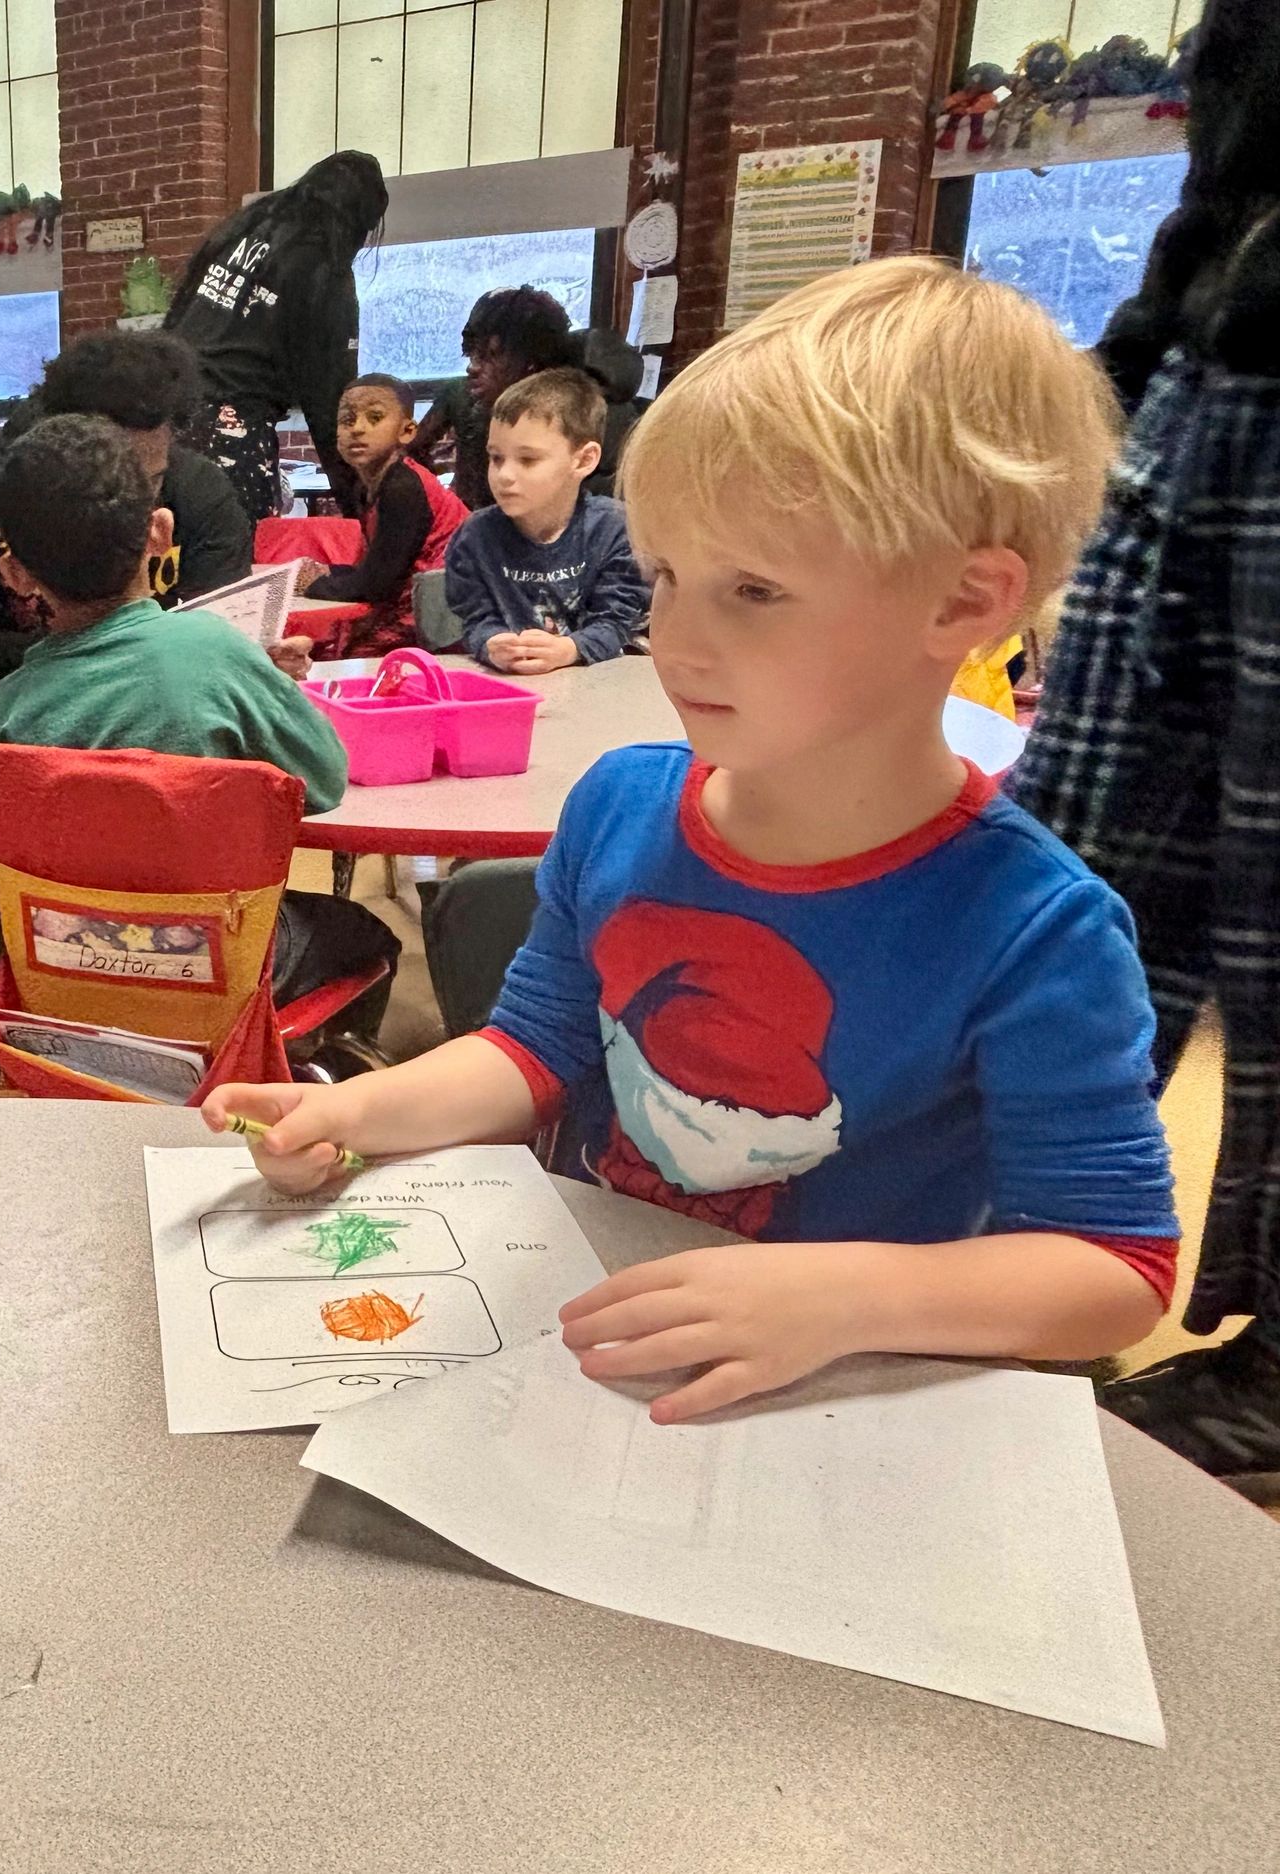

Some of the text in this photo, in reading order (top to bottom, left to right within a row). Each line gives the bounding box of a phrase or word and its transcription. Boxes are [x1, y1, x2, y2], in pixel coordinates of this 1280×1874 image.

[233, 274, 279, 306] BARS
[79, 943, 194, 978] Daxton 6
[470, 1178, 513, 1189] Your
[375, 1194, 425, 1204] What
[505, 1242, 548, 1252] and
